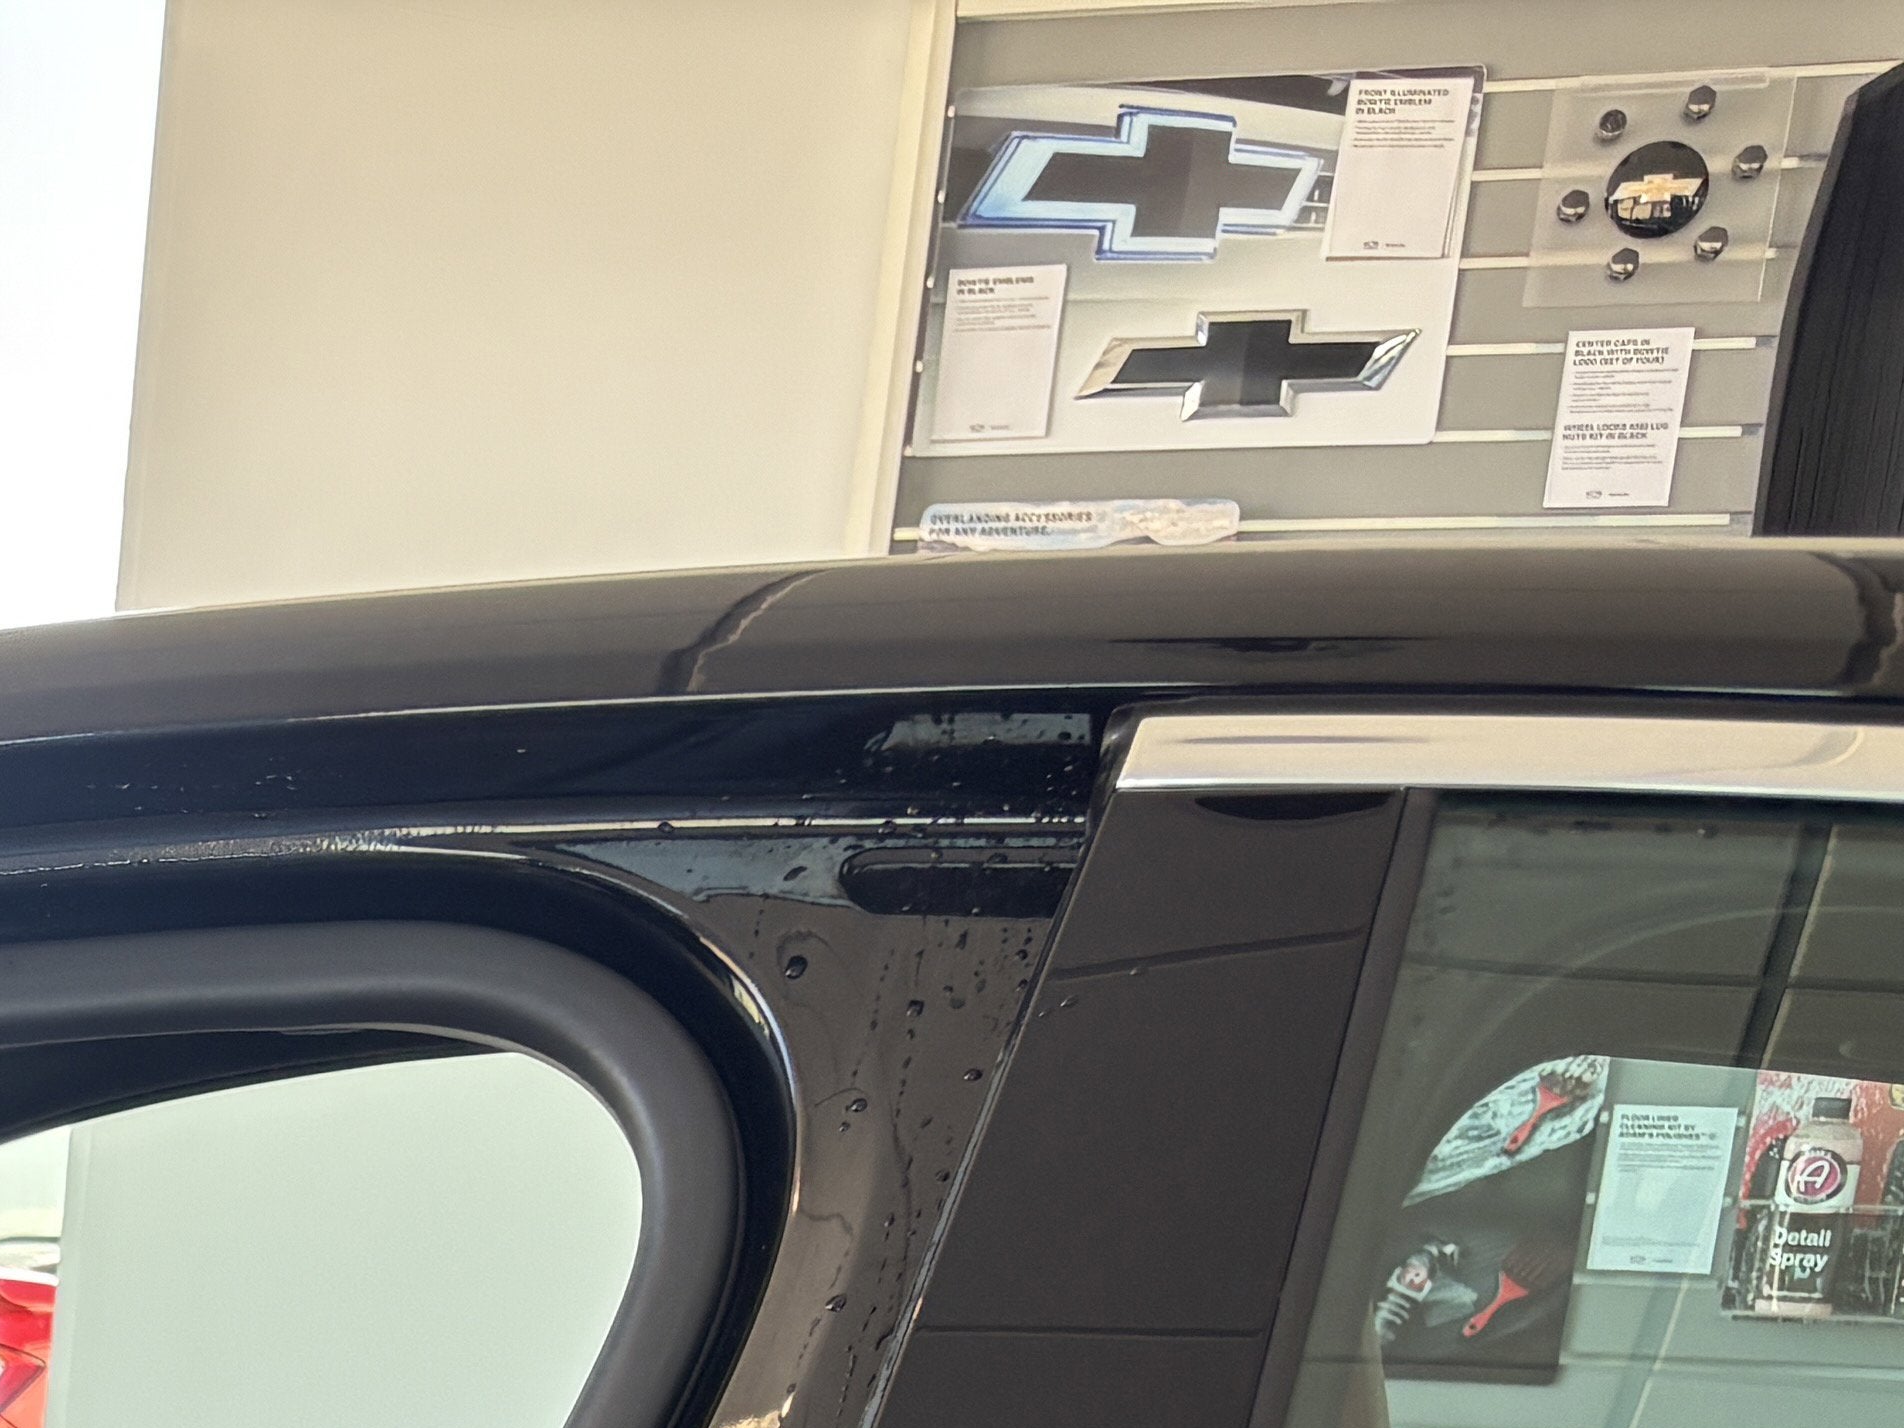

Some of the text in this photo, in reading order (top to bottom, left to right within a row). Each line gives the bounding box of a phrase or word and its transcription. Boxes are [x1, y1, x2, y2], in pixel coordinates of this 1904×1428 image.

[1359, 89, 1387, 97] FRONT
[1576, 339, 1611, 348] CENTER
[1613, 339, 1638, 347] CAPS
[1574, 347, 1669, 357] BLACK WITH BOWTIE
[1622, 357, 1634, 365] OF
[1617, 432, 1648, 440] BLACK
[930, 511, 1093, 525] OVERLANDING ACCESSORIES
[954, 527, 977, 537] ANY
[1775, 1227, 1832, 1248] Detail
[1769, 1248, 1829, 1272] Spray
